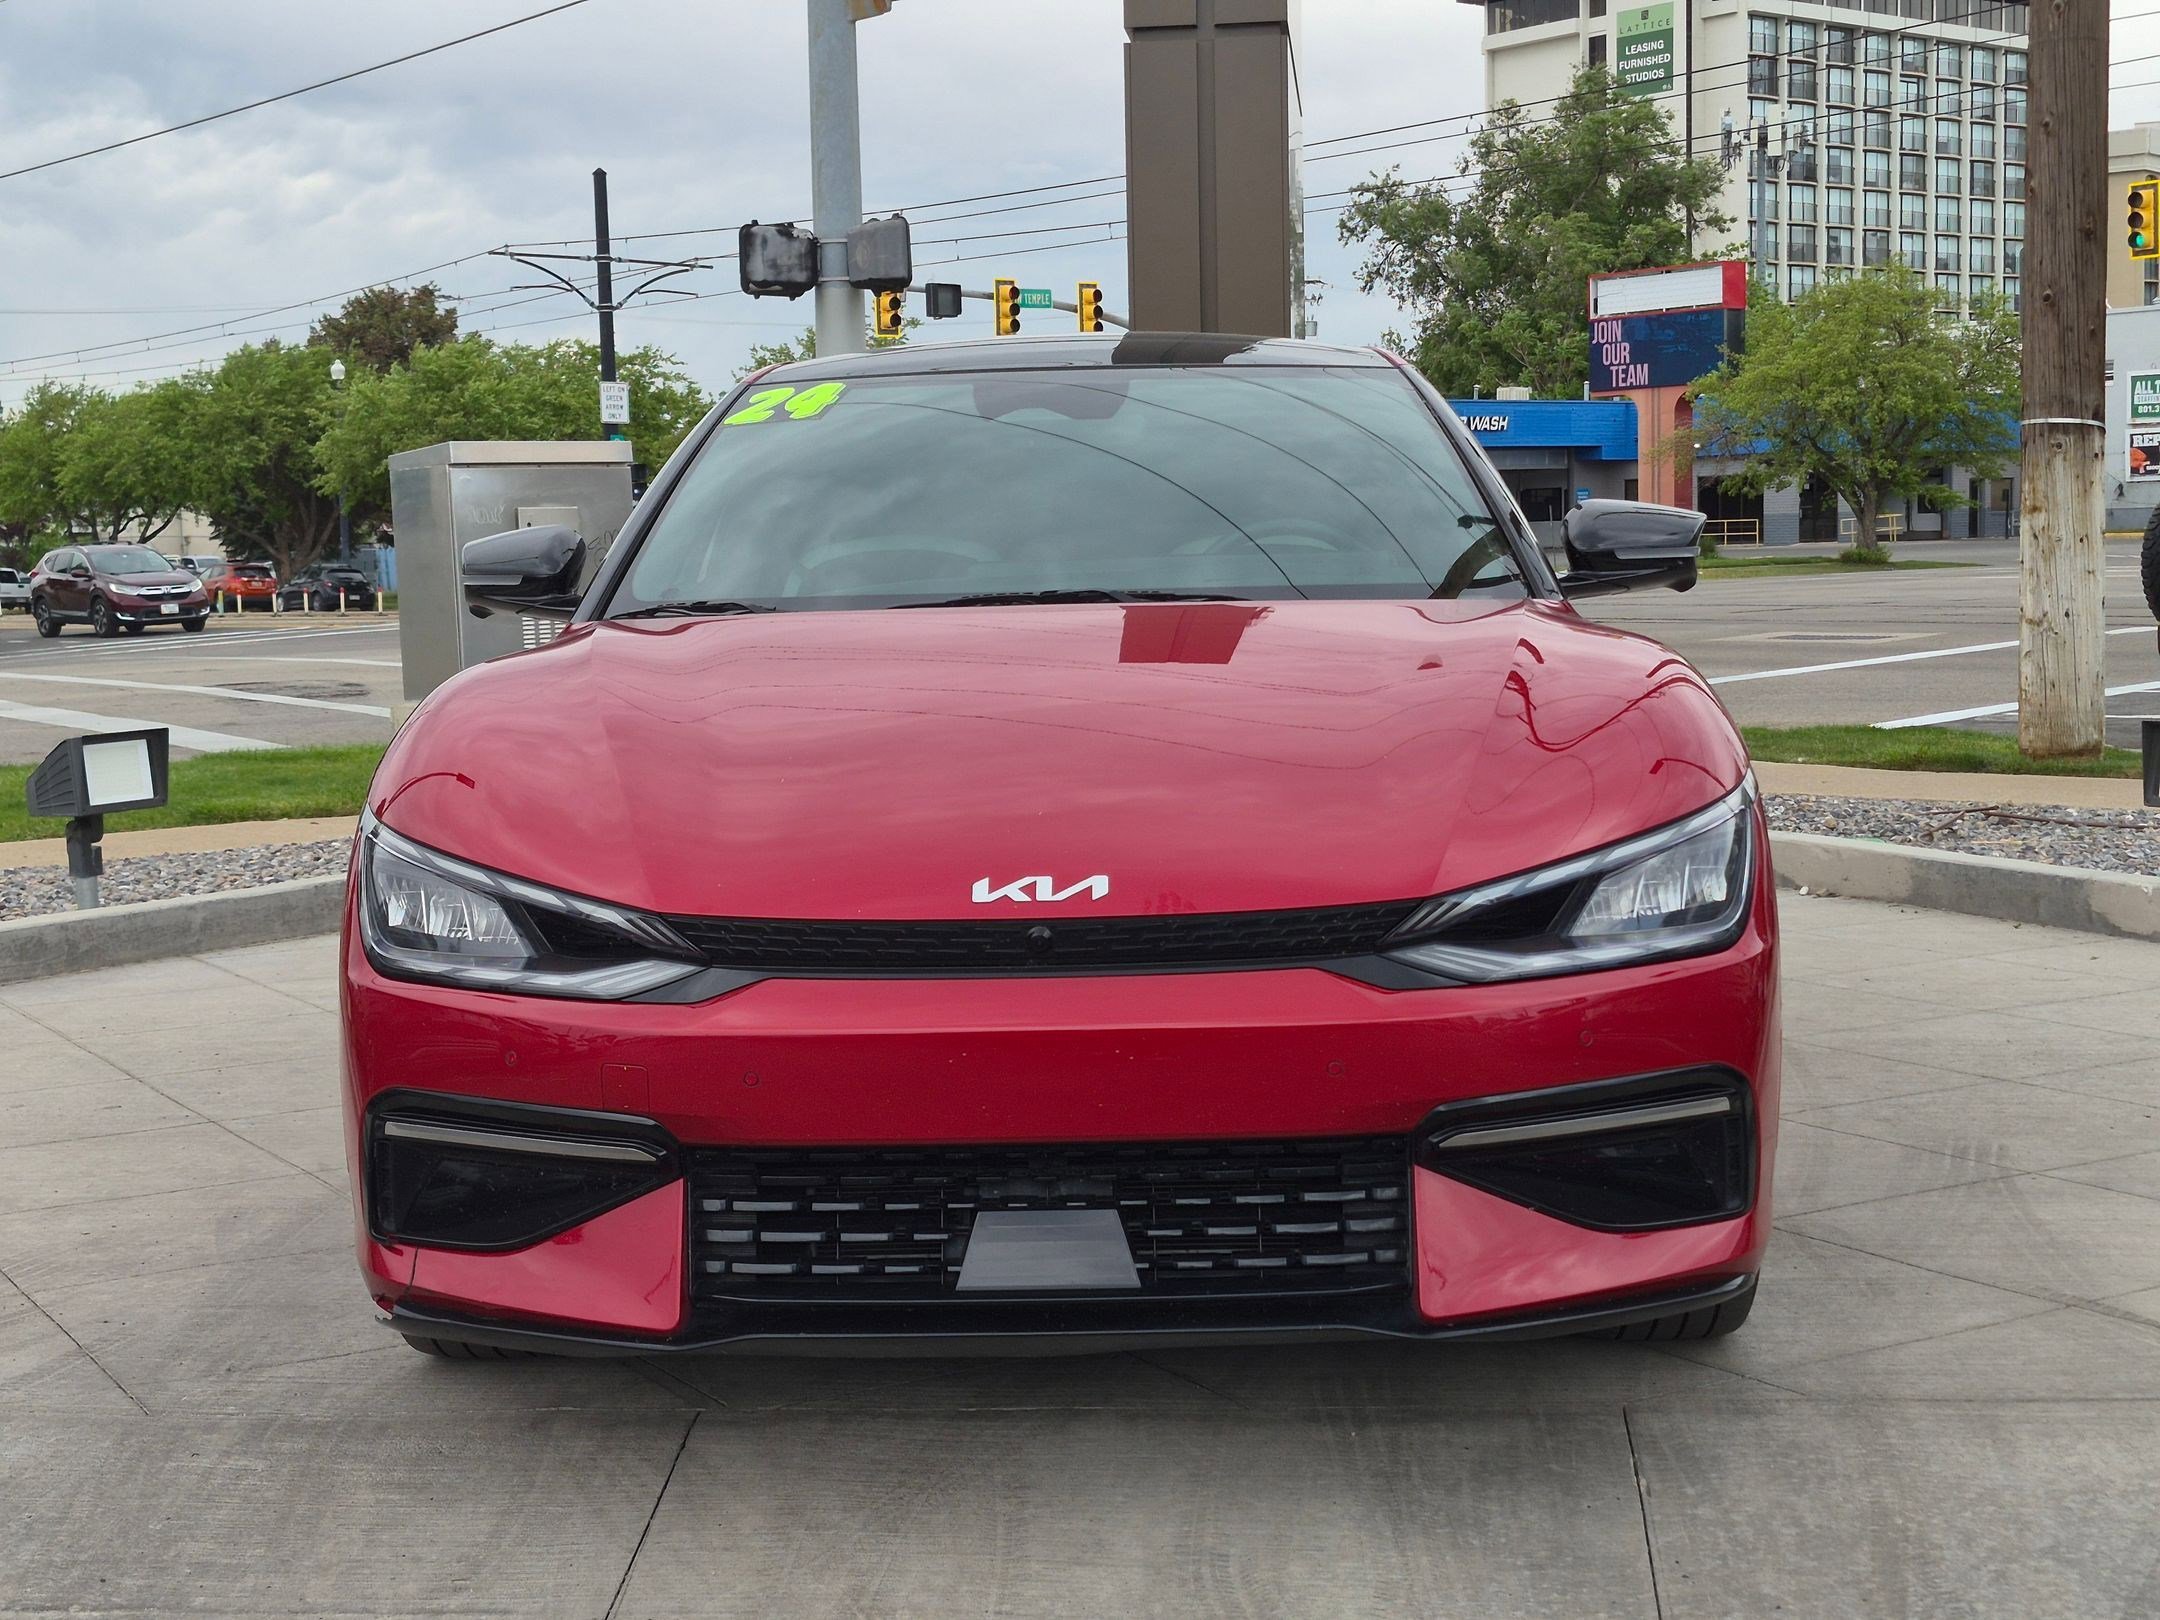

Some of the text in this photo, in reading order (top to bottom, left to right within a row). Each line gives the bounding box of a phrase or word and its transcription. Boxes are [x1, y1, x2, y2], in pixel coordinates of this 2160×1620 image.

[1619, 17, 1671, 35] LATTICE
[1625, 39, 1665, 55] LEASING
[1619, 53, 1671, 71] FURNISHED
[1625, 68, 1665, 84] STUDIOS
[1024, 293, 1050, 305] TEMPLE
[1591, 319, 1622, 345] JOIN
[1602, 342, 1630, 366] OUR
[1609, 363, 1649, 388] TEAM
[723, 382, 847, 426] 24
[1470, 416, 1509, 431] WASH
[971, 874, 1109, 904] KIA
